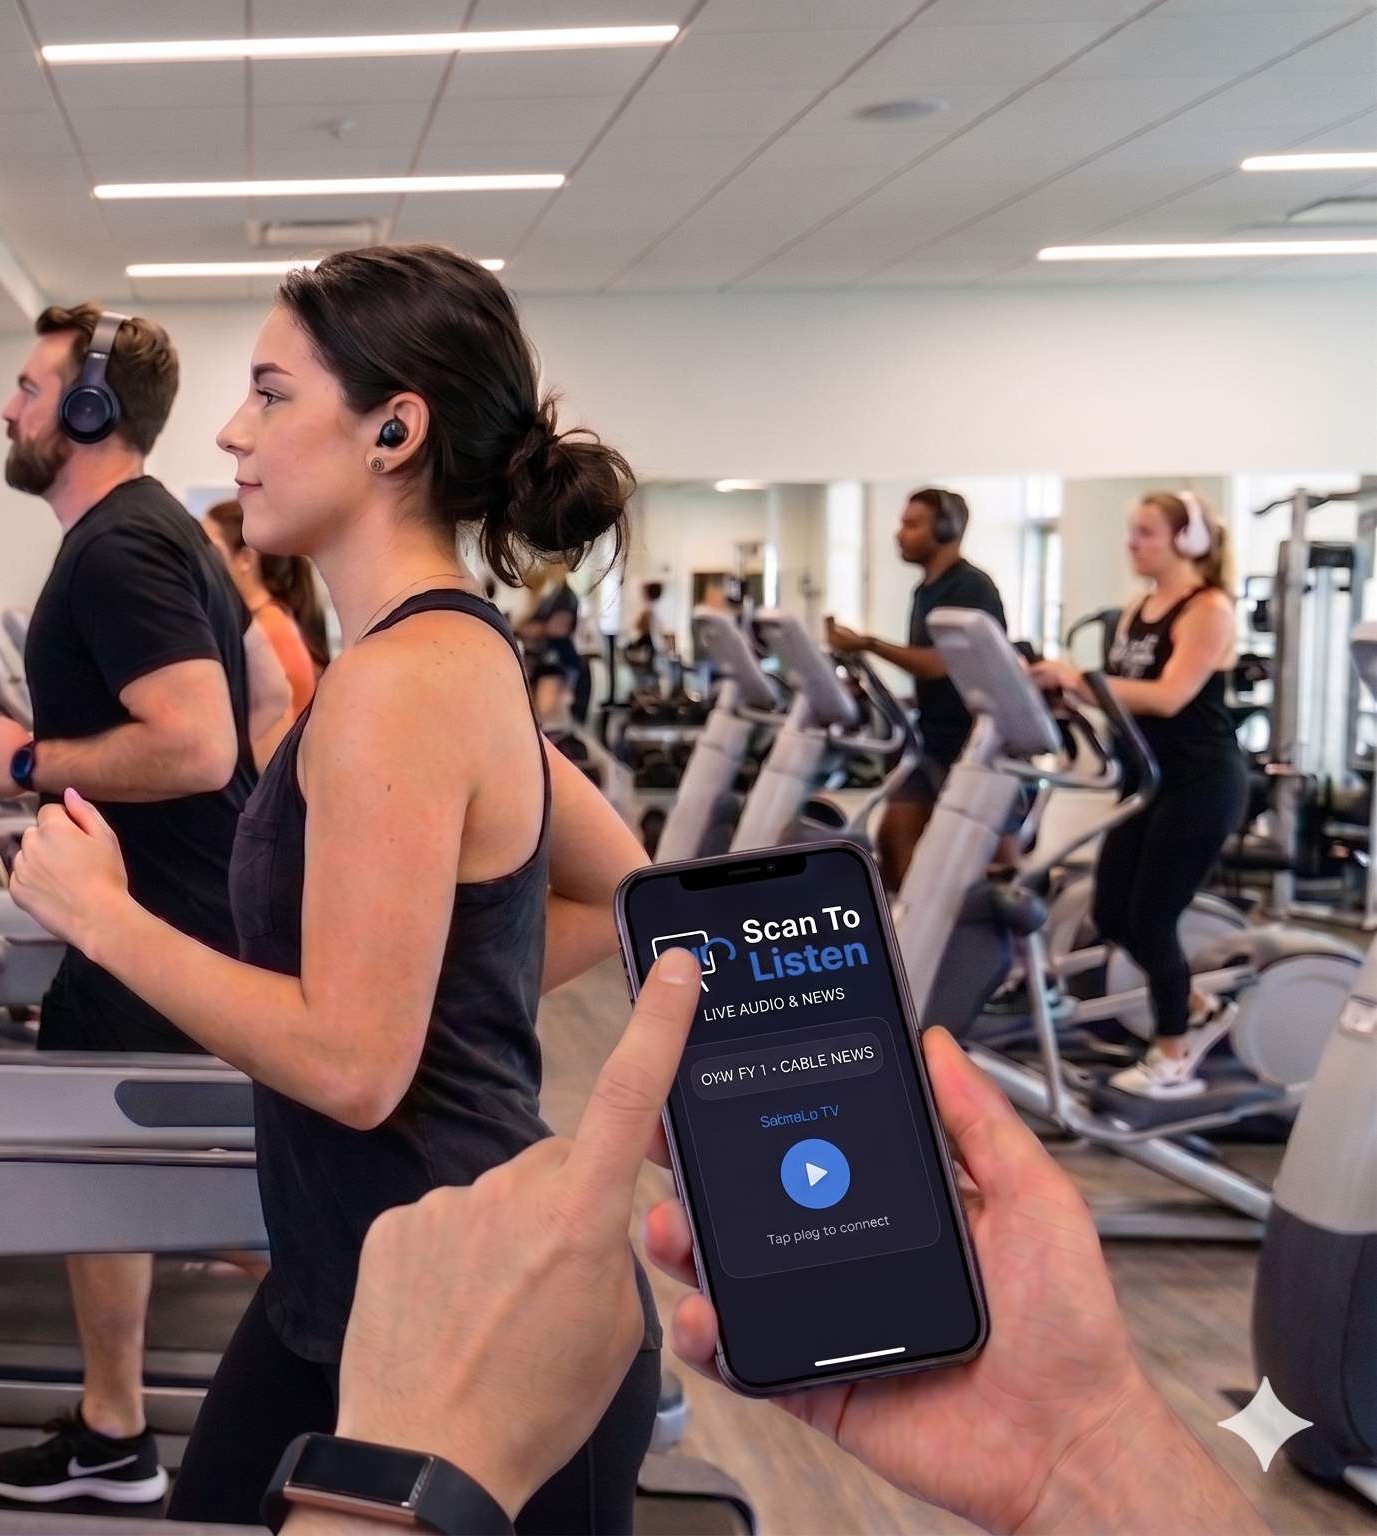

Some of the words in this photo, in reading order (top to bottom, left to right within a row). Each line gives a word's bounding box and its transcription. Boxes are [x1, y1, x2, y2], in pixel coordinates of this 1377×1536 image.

[742, 915, 818, 944] Scan
[821, 905, 861, 931] To
[749, 942, 869, 982] Listen
[703, 1004, 737, 1022] LIVE
[739, 997, 785, 1017] AUDIO
[788, 995, 799, 1008] &
[801, 987, 846, 1007] NEWS
[780, 1053, 828, 1074] CABLE
[830, 1045, 875, 1066] NEWS
[819, 1104, 839, 1119] TV
[766, 1233, 792, 1246] Tap
[823, 1225, 837, 1236] to
[839, 1215, 891, 1234] connect
